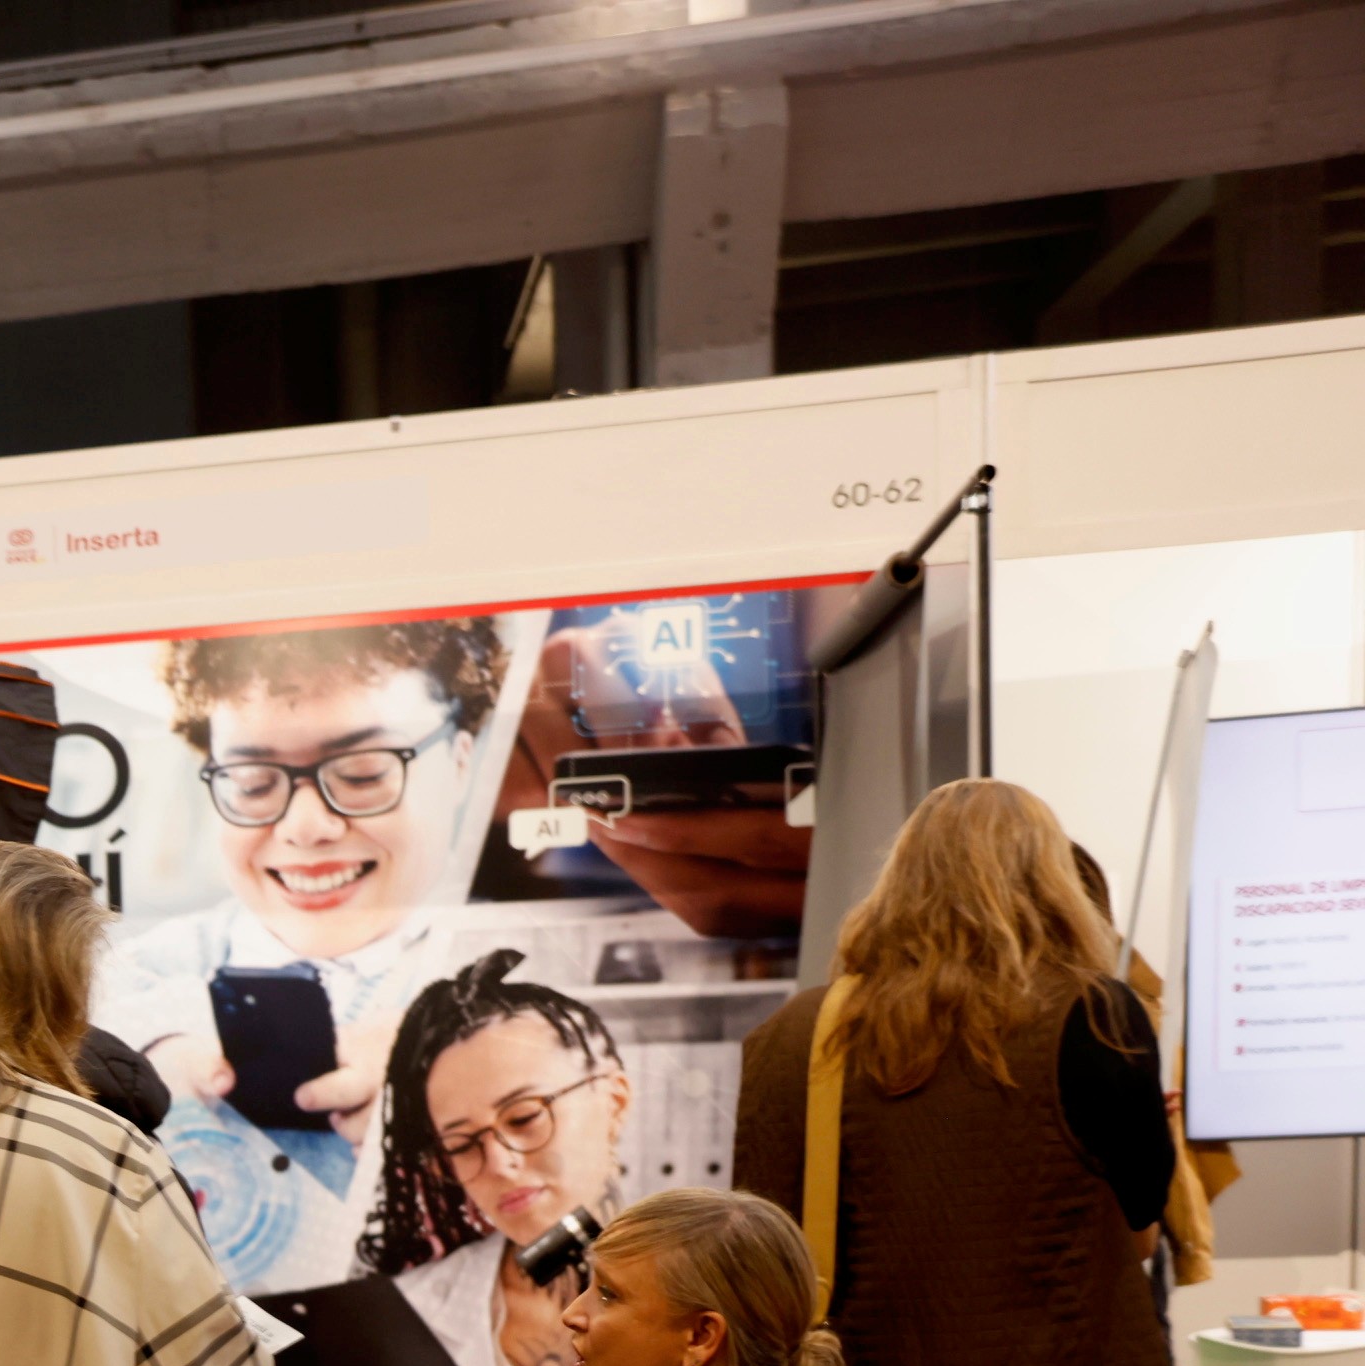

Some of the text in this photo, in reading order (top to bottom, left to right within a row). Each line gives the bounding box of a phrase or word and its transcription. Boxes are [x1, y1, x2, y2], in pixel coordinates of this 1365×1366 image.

[832, 478, 923, 508] 60-62
[66, 527, 159, 553] Inserta
[652, 619, 693, 651] AI
[536, 820, 560, 838] AI
